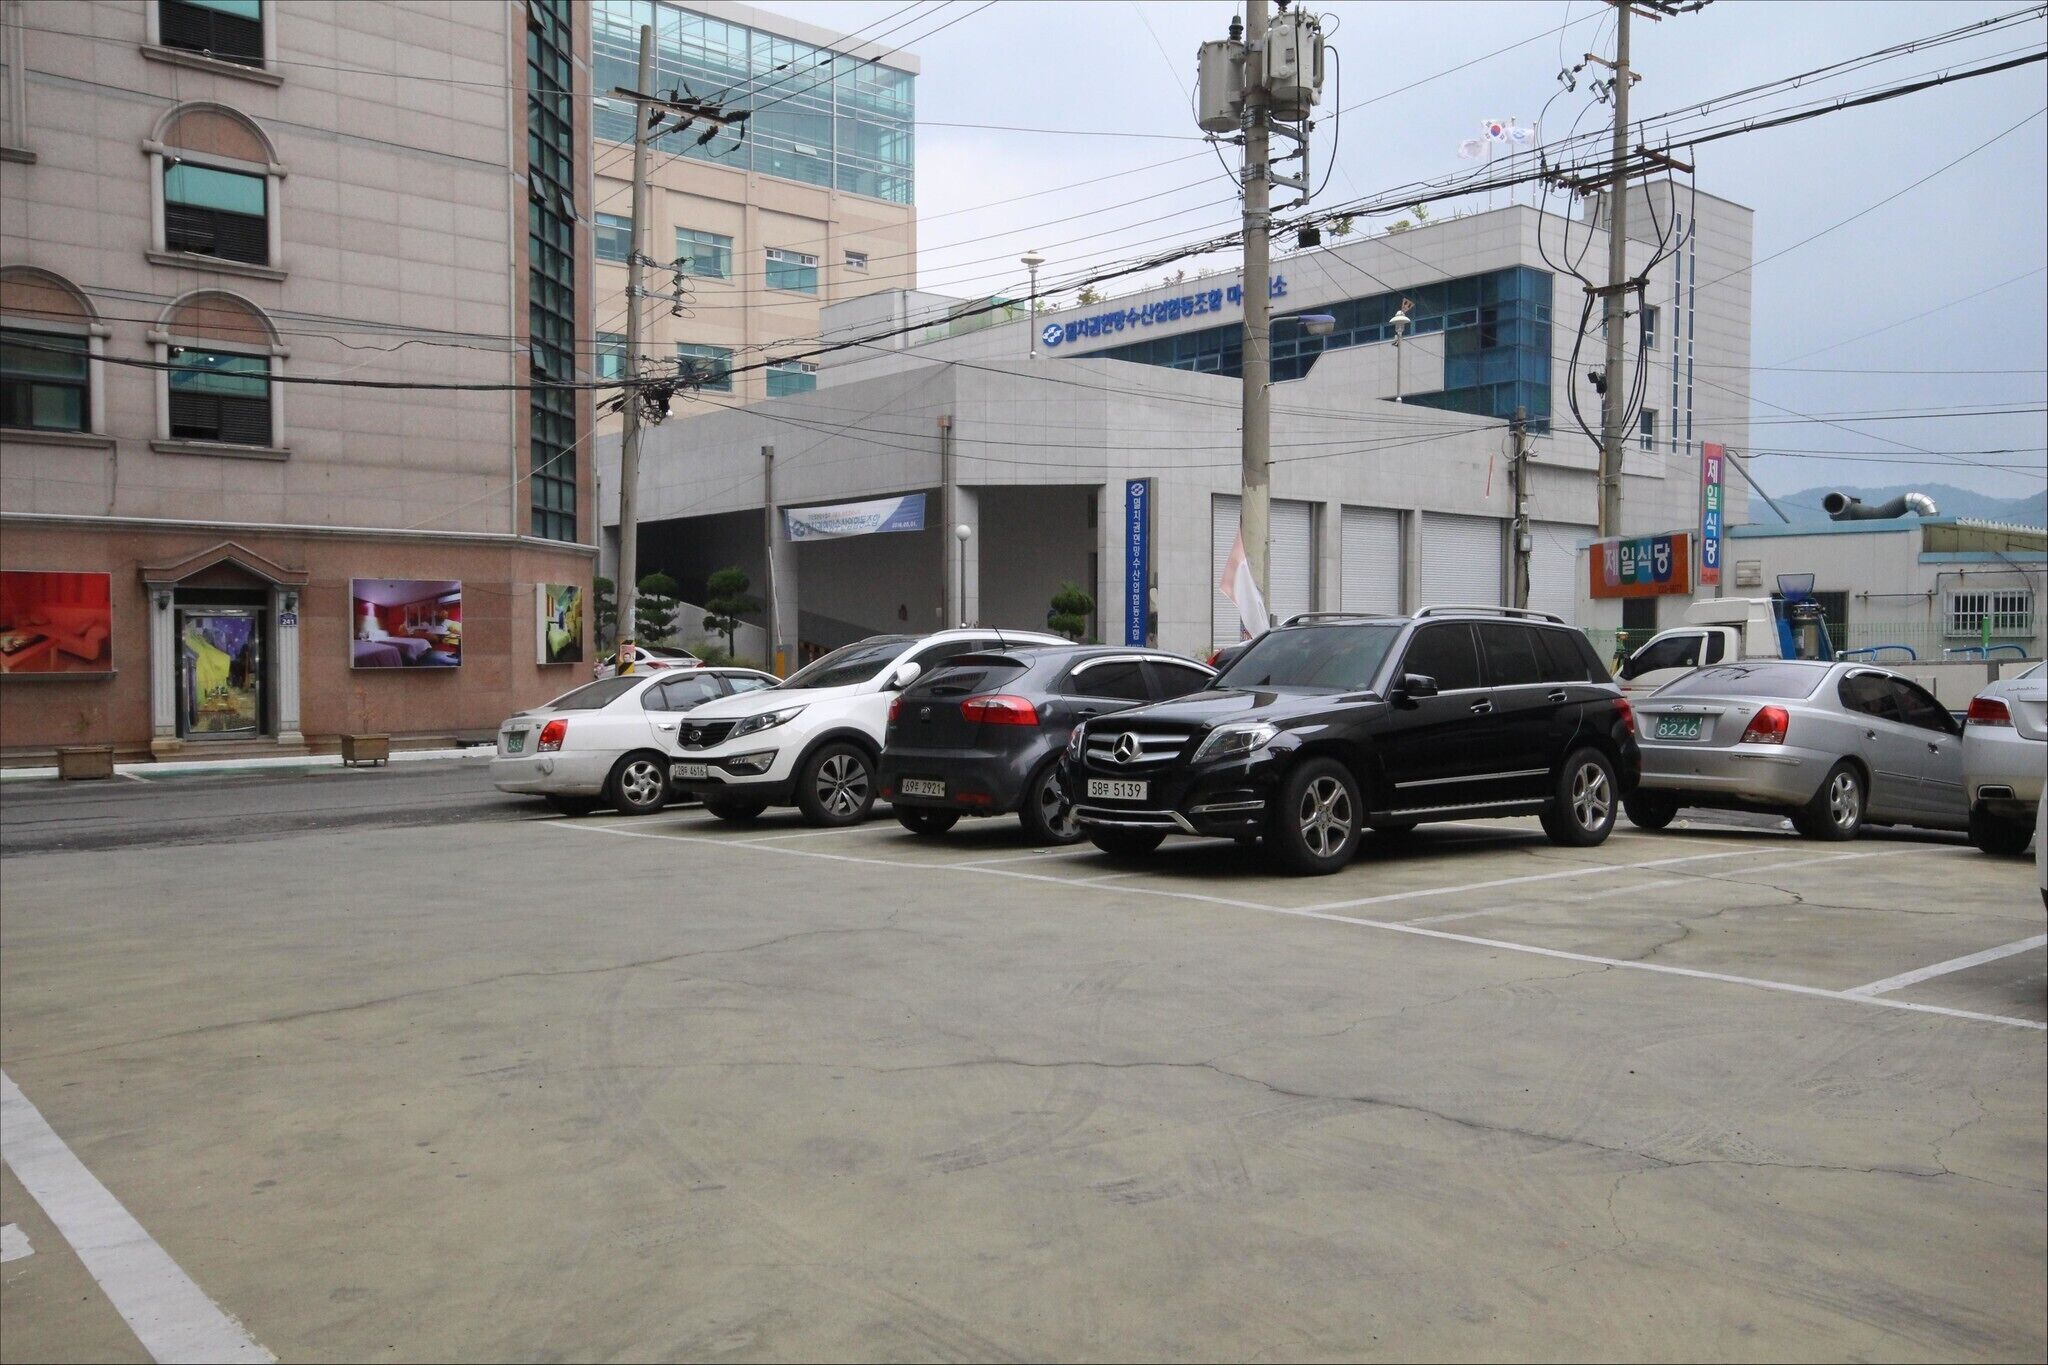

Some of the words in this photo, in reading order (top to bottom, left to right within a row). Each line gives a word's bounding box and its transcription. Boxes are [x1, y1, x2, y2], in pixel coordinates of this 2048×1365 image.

[1065, 287, 1223, 342] 멸치권현망수산업협동조합
[1706, 458, 1718, 565] 제일식당
[1132, 497, 1141, 641] 멸치권현망수산업협동조합
[1604, 543, 1670, 576] 제일식당
[1658, 723, 1698, 736] 8246
[921, 781, 941, 795] 2921
[1092, 781, 1109, 796] 58무
[1113, 782, 1142, 797] 5139
